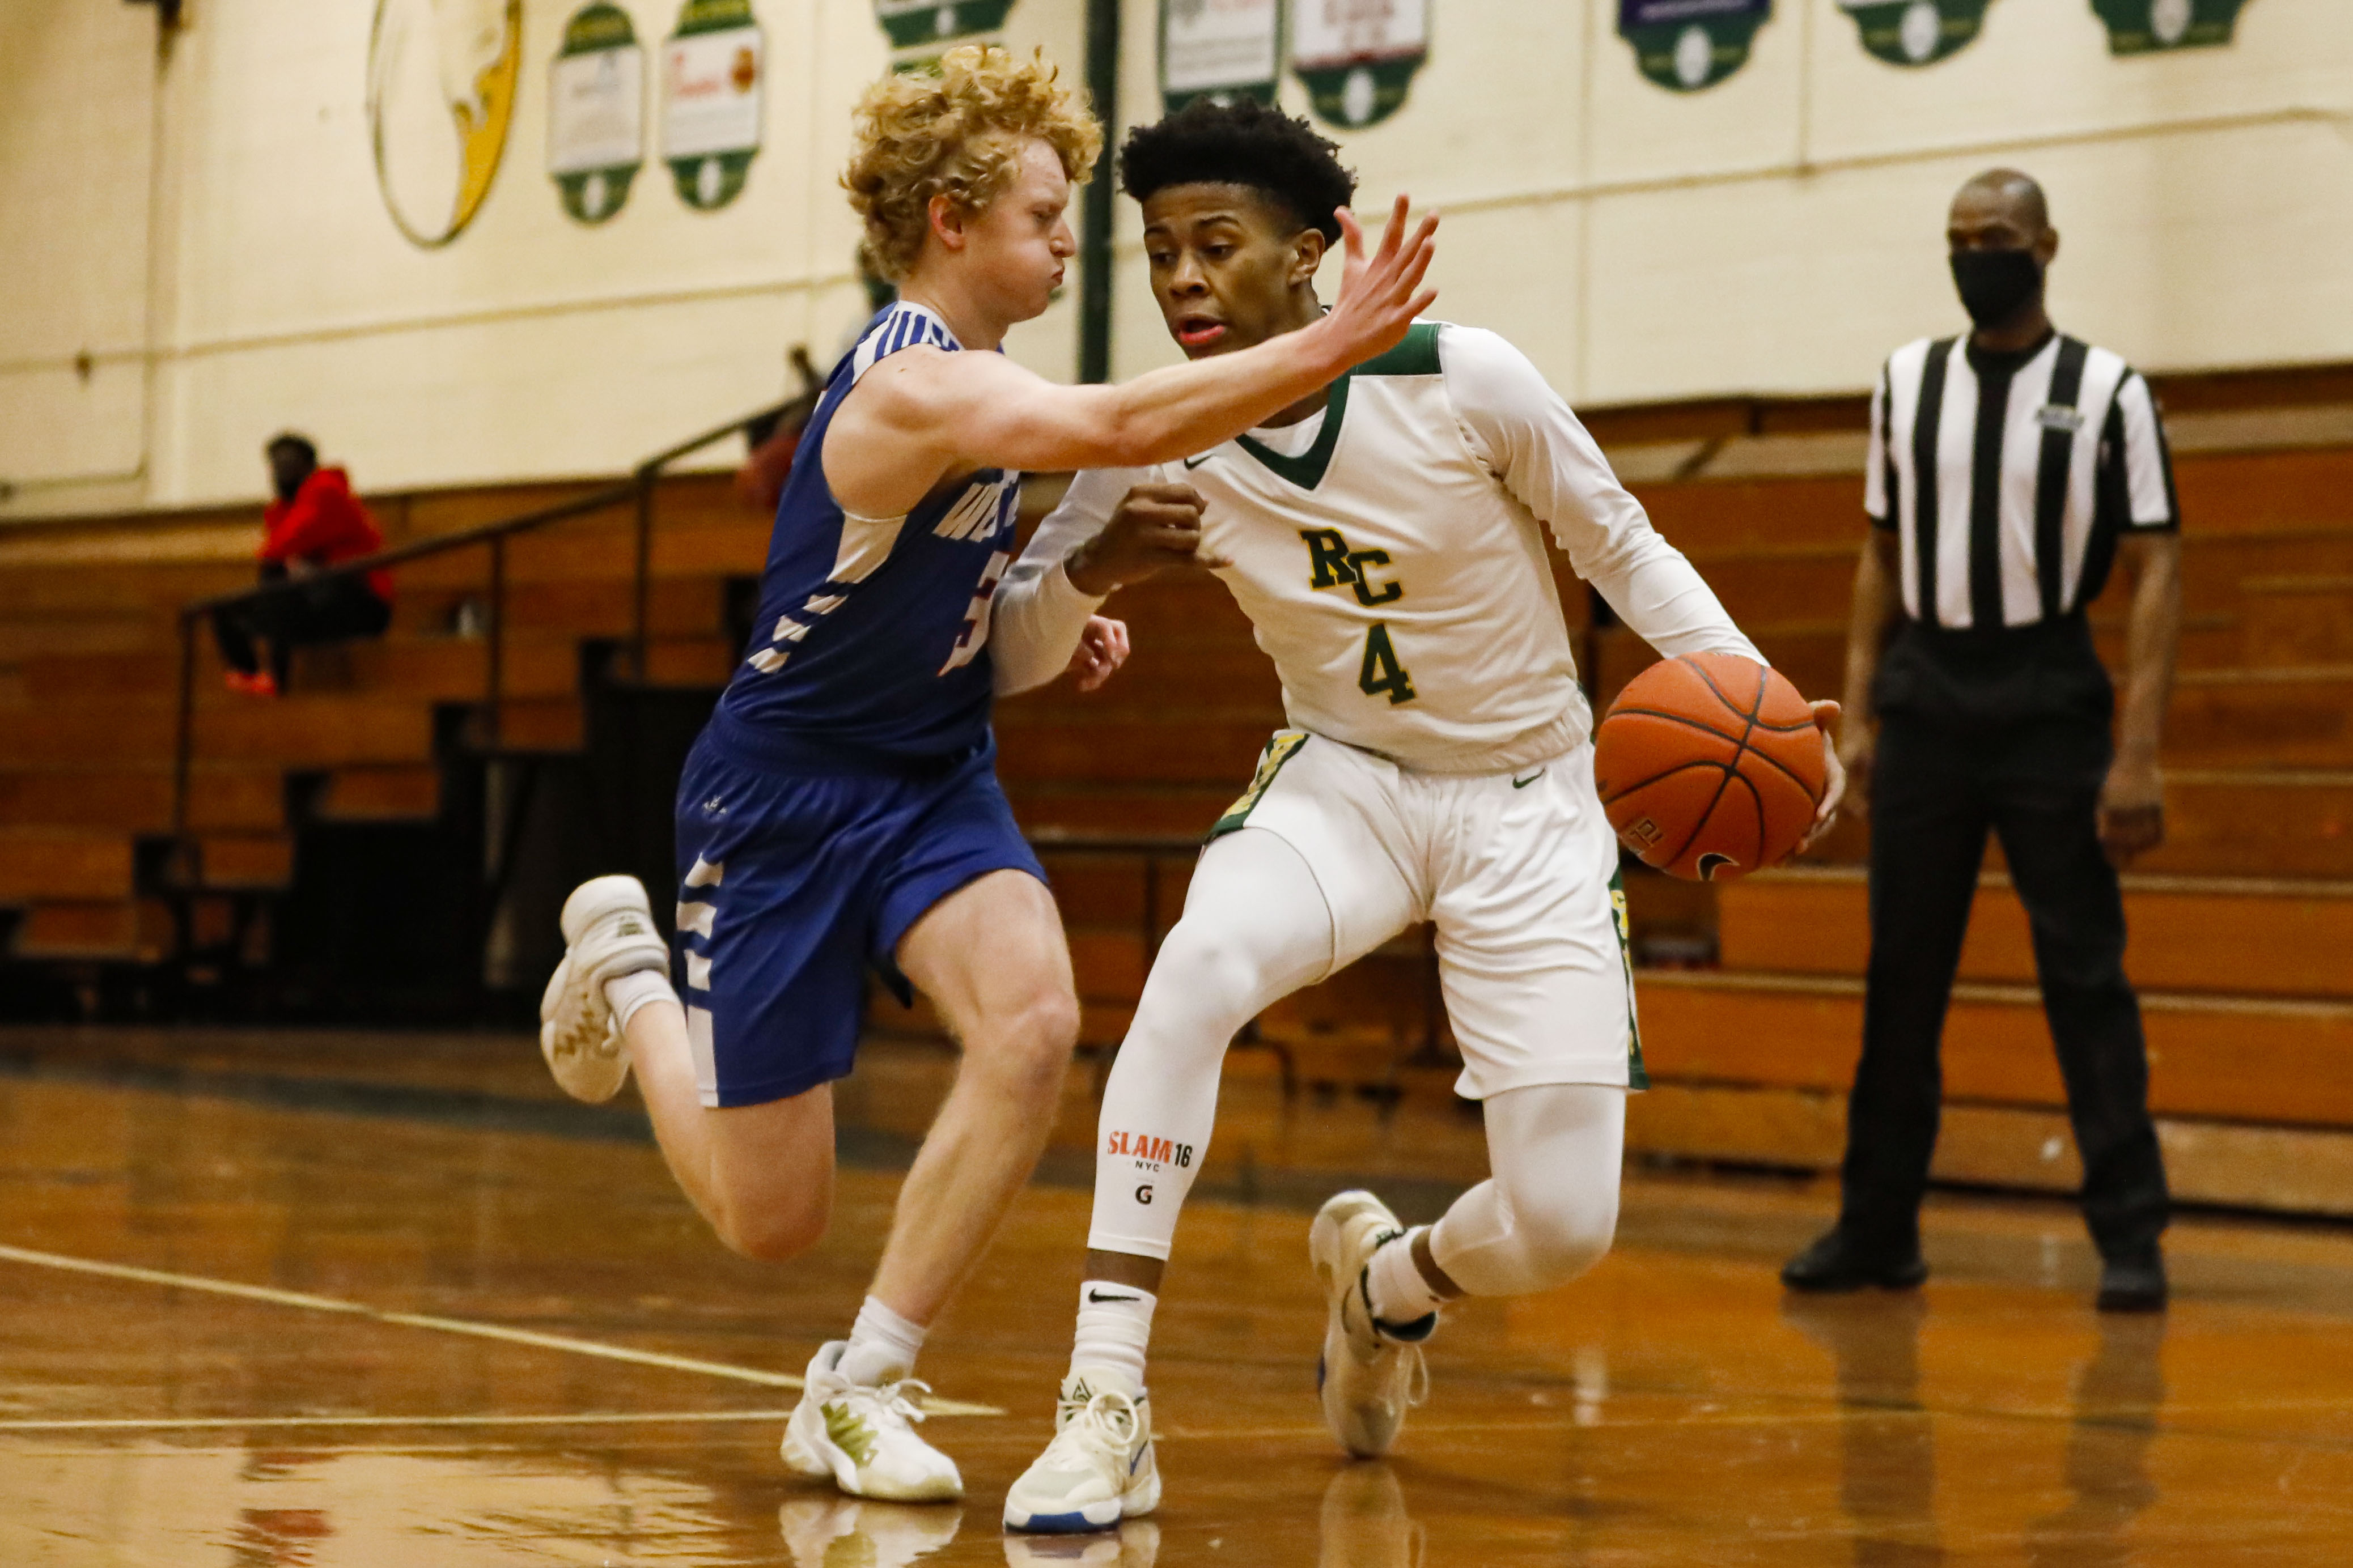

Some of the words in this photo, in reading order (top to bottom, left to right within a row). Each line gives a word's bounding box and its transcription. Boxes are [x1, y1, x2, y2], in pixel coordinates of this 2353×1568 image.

[1298, 527, 1404, 606] RC
[1358, 620, 1417, 706] 4
[1135, 1160, 1160, 1172] NYC
[1135, 1184, 1153, 1205] G
